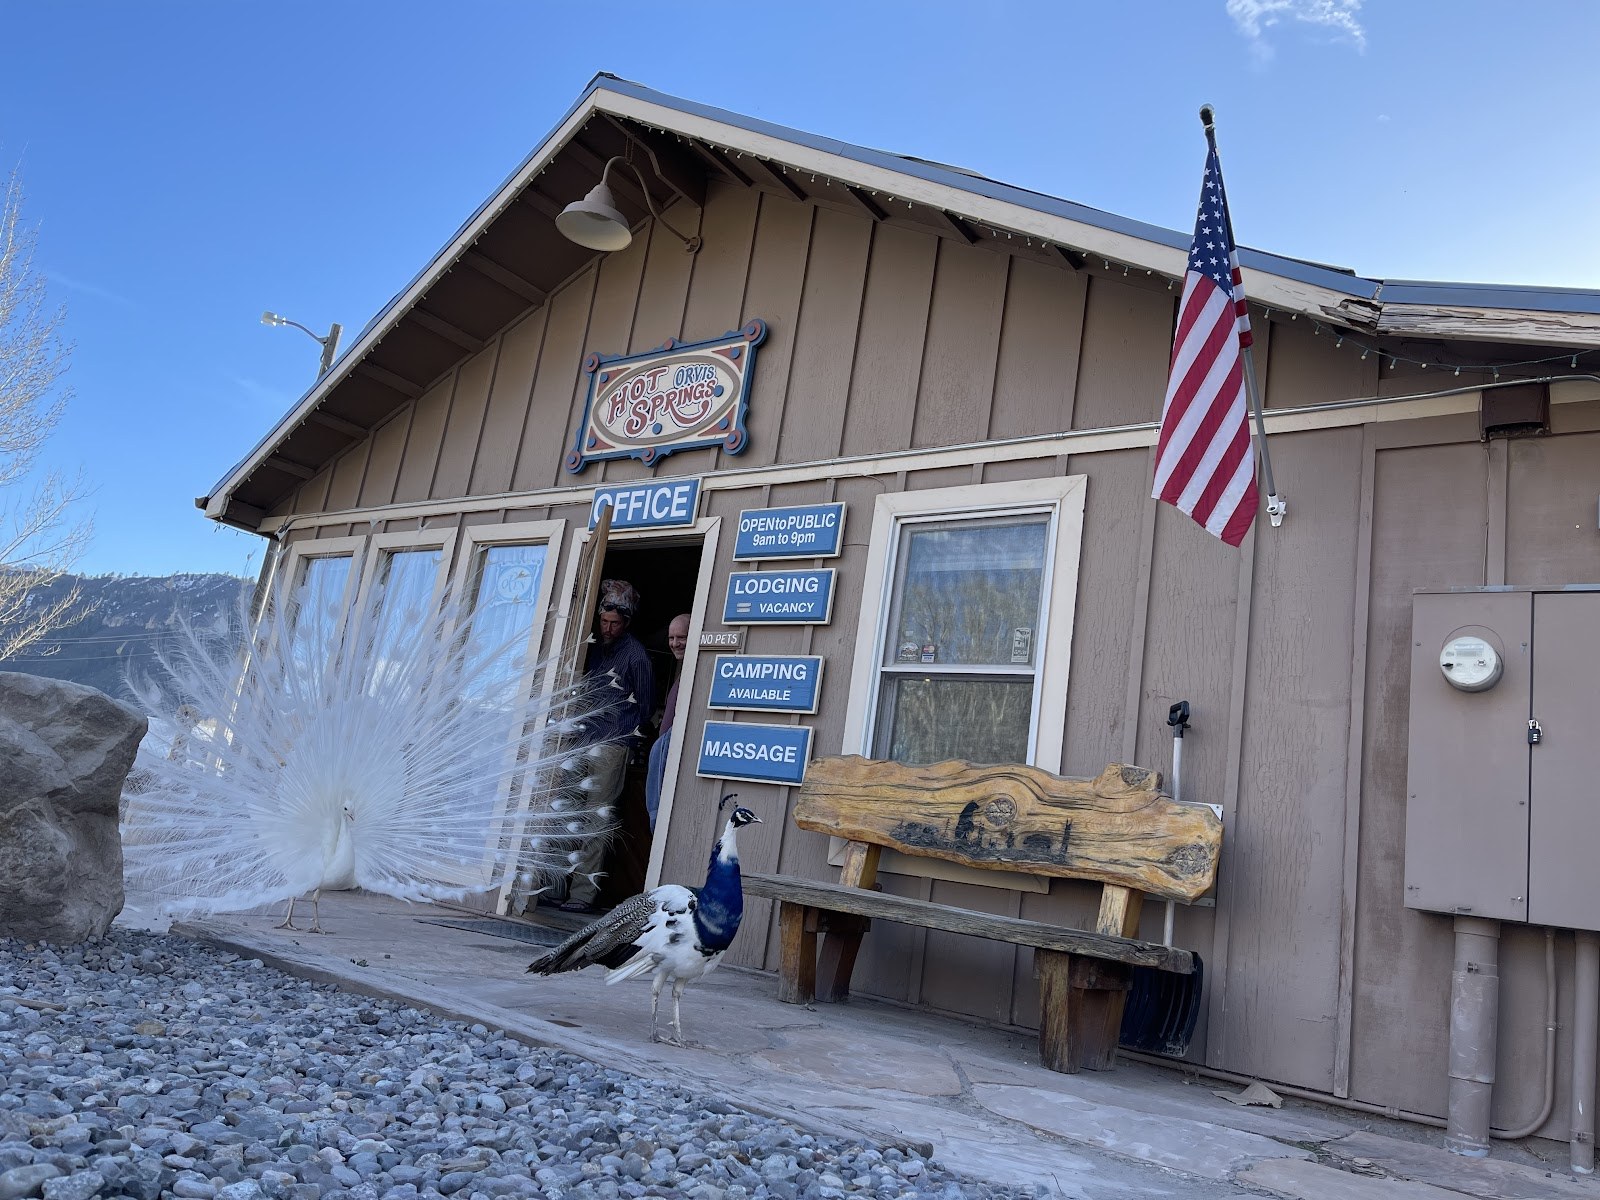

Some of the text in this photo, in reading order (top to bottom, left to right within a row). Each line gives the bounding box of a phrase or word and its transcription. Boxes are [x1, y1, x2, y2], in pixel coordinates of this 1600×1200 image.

[675, 366, 715, 387] ORVIS
[607, 367, 668, 425] HOT
[625, 379, 717, 435] SPRINGS
[593, 485, 691, 524] OFFICE
[752, 531, 816, 547] 9am to 9pm
[734, 577, 819, 595] LODGING
[759, 602, 815, 613] VACANCY
[700, 633, 738, 645] NO PETS
[720, 662, 807, 681] CAMPING
[728, 688, 792, 701] AVAILABLE
[704, 740, 798, 763] MASSAGE
